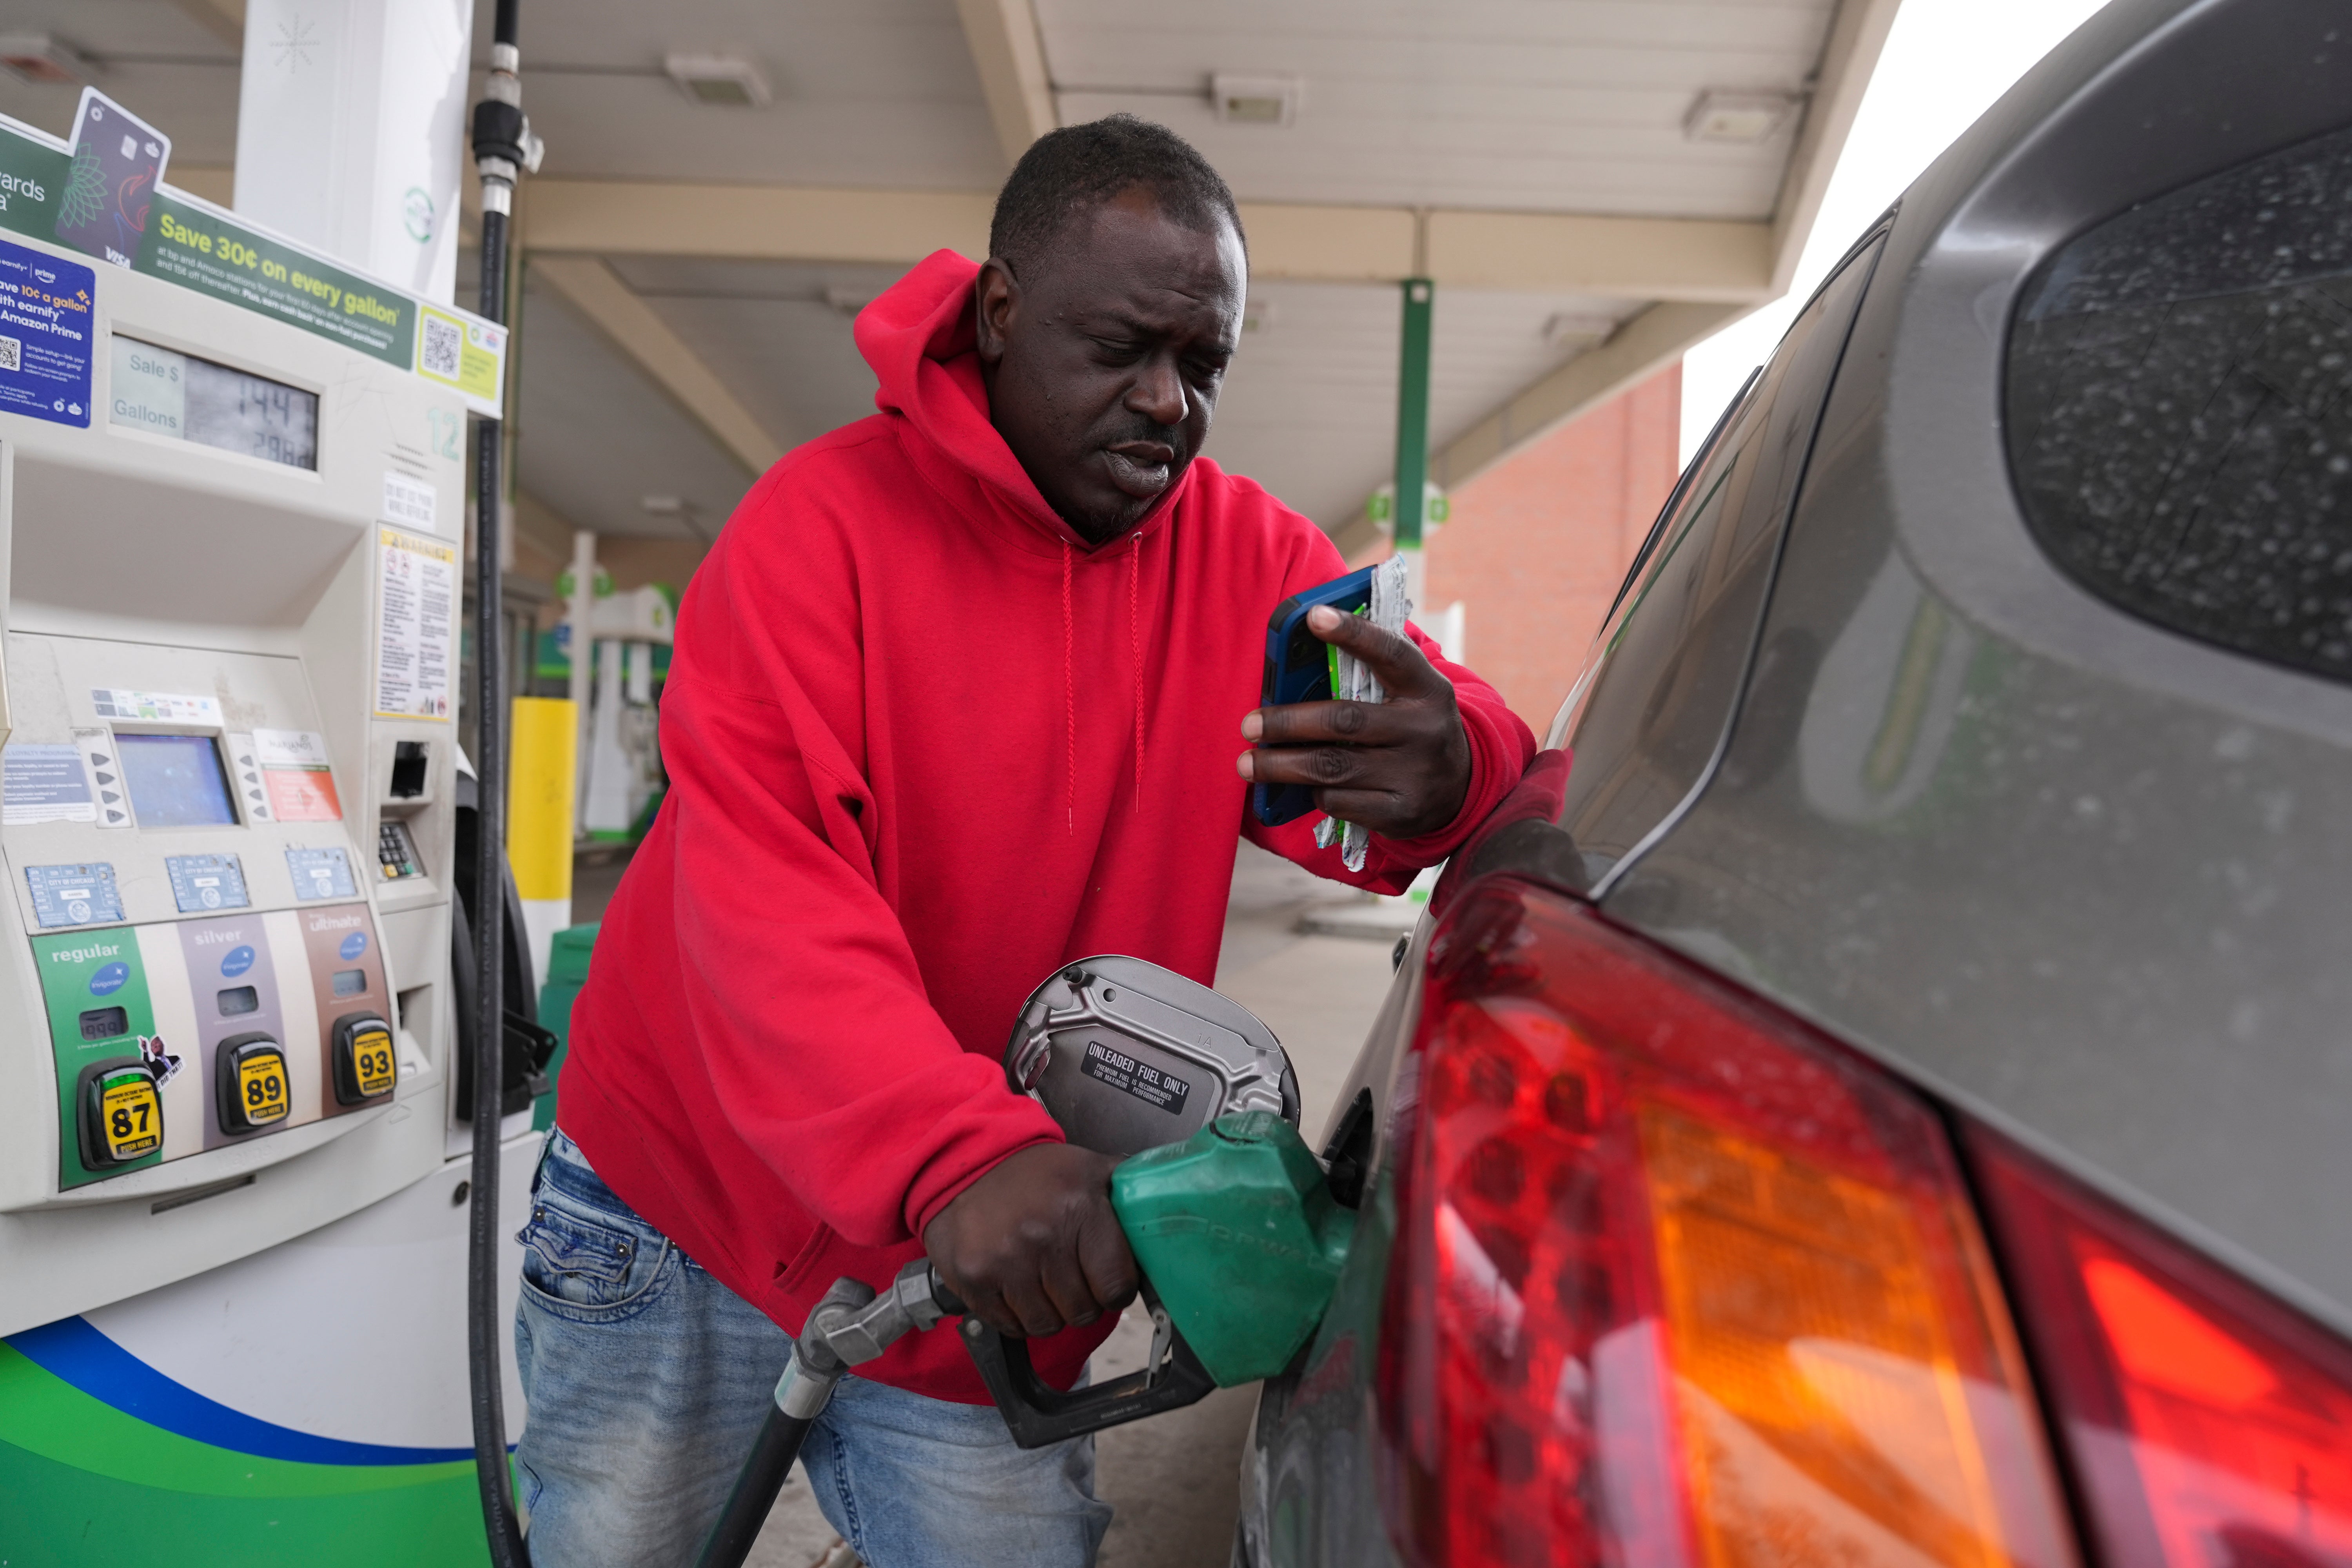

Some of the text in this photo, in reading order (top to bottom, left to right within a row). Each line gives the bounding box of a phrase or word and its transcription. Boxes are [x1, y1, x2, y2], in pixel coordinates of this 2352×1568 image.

[105, 245, 131, 270] VISA
[160, 214, 212, 253] Save
[216, 237, 258, 270] 30¢
[261, 258, 287, 283] on
[291, 270, 342, 308] every
[34, 268, 56, 280] prime
[22, 284, 40, 299] 10¢
[42, 293, 51, 303] a
[53, 296, 87, 314] gallon
[0, 309, 82, 341] Amazon Prime
[25, 352, 50, 363] accounts
[26, 343, 44, 354] Simple
[130, 355, 179, 383] Sale $
[114, 399, 177, 428] Gallons
[427, 407, 459, 463] 12
[195, 929, 241, 945] silver
[309, 915, 361, 932] ultimate
[52, 944, 119, 964] regular
[91, 979, 123, 989] Invigorate
[160, 1073, 170, 1087] DID
[169, 1062, 183, 1078] THAT!
[360, 1051, 390, 1077] 93
[1089, 1042, 1189, 1096] UNLEADED FUEL ONLY
[247, 1076, 281, 1105] 89
[1093, 1070, 1165, 1106] FOR MAXIMUM PERFORMANCE
[1096, 1063, 1118, 1078] PREMIUM
[1119, 1072, 1130, 1083] FUEL
[1138, 1081, 1172, 1101] RECOMMENDED
[112, 1103, 150, 1138] 87
[254, 1106, 281, 1118] PUSH HERE
[121, 1138, 153, 1153] PUSH HERE
[488, 1481, 505, 1534] FUTURA
